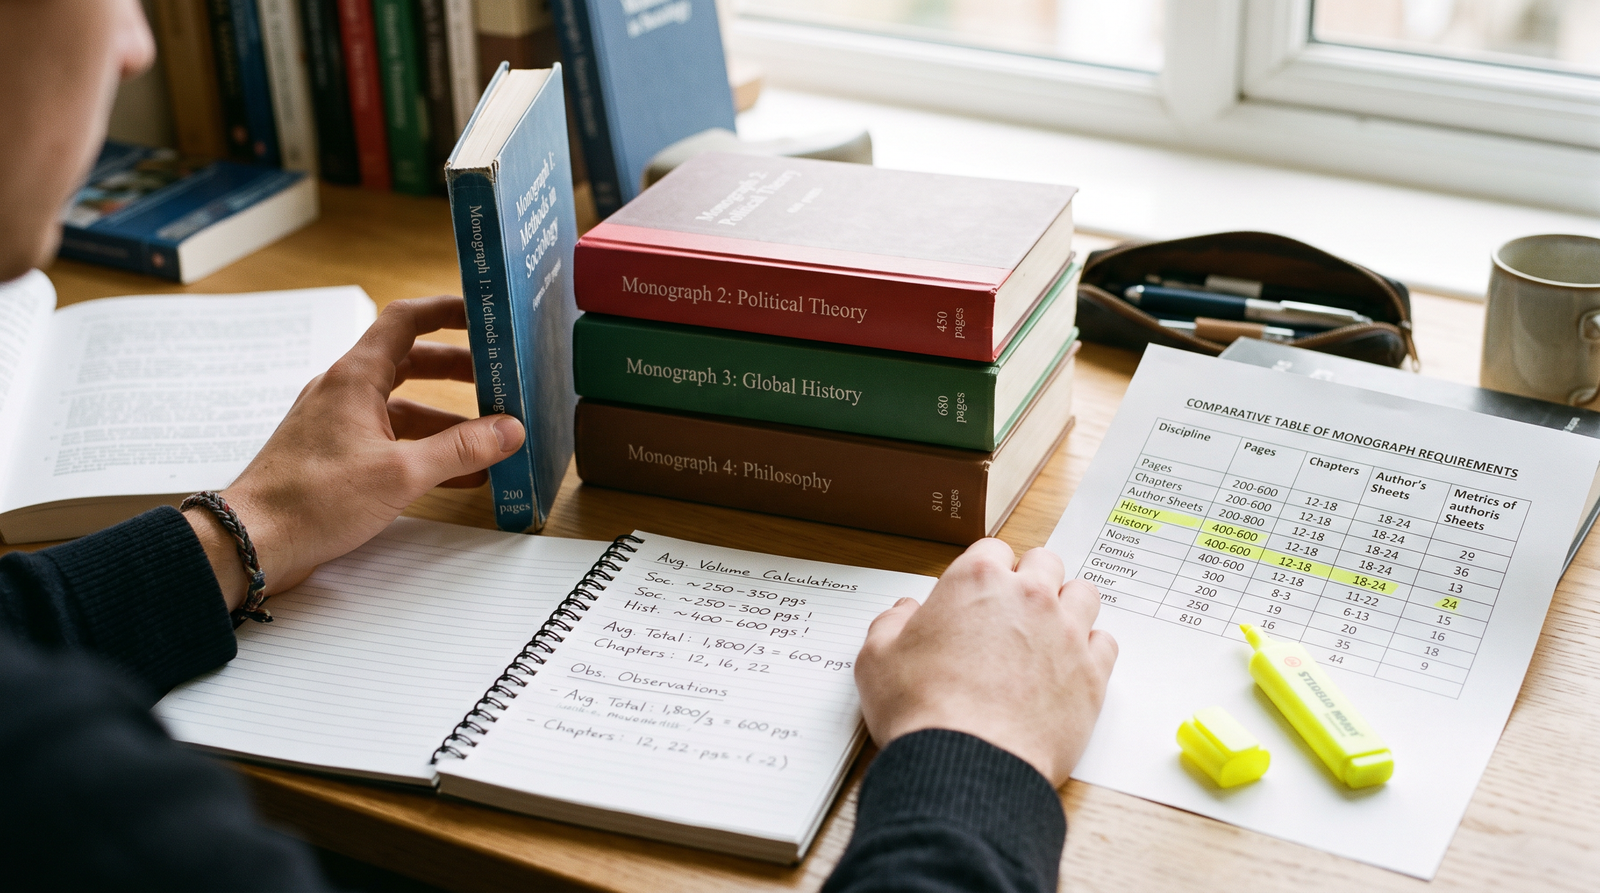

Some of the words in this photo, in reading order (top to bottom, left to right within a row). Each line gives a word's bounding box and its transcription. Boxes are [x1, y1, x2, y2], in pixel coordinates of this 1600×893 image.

[516, 159, 550, 221] Monograph
[470, 205, 490, 274] Monograph
[519, 193, 549, 251] Methods
[526, 217, 558, 278] Sociology
[480, 279, 492, 290] 1:
[622, 276, 712, 304] Monograph
[717, 287, 732, 304] 2:
[738, 289, 803, 313] Political
[808, 298, 868, 324] Theory
[481, 294, 498, 344] Methods
[936, 311, 948, 332] 450
[955, 308, 966, 339] pages
[488, 347, 501, 359] in
[490, 362, 507, 414] Sociolog
[626, 358, 717, 386] Monograph
[722, 370, 737, 386] 3:
[742, 372, 796, 394] Global
[801, 379, 862, 406] History
[938, 396, 949, 416] 680
[956, 392, 967, 423] pages
[1159, 422, 1211, 442] Discipline
[1186, 398, 1272, 424] COMPARATIVE
[1274, 416, 1311, 433] TABLE
[1313, 426, 1330, 436] OF
[1331, 430, 1416, 455] MONOGRAPH
[1418, 448, 1519, 478] REQUIREMENTS
[1244, 442, 1277, 457] Pages
[628, 444, 718, 475] Monograph
[722, 460, 738, 476] 4:
[744, 462, 832, 493] Philosophy
[1310, 457, 1360, 476] Chapters
[500, 504, 530, 515] pages
[502, 490, 523, 500] 200
[932, 492, 943, 512] 810
[950, 489, 961, 519] pages
[1134, 472, 1182, 491] Chapters
[1225, 494, 1272, 512] 200-600
[1299, 512, 1332, 527] 12-18
[1372, 529, 1405, 544] 18-24
[1141, 458, 1173, 473] Pages
[1232, 479, 1278, 498] 200-600
[1305, 496, 1338, 512] 12-18
[1378, 514, 1411, 529] 18-24
[1370, 484, 1410, 500] Sheets
[1454, 488, 1499, 507] Metrics
[1503, 499, 1517, 510] of
[1127, 486, 1166, 503] Author
[1167, 496, 1204, 513] Sheets
[1218, 509, 1265, 527] 200-800
[1292, 526, 1325, 542] 12-18
[1365, 544, 1399, 560] 18-24
[1454, 566, 1469, 577] 36
[1444, 514, 1485, 531] Sheets
[1113, 514, 1153, 532] History
[1204, 538, 1251, 557] 400-600
[1278, 557, 1312, 572] 12-18
[1352, 575, 1386, 591] 18-24
[1441, 599, 1458, 610] 24
[1120, 500, 1160, 519] History
[1212, 523, 1258, 542] 400-600
[1285, 542, 1319, 557] 12-18
[1358, 560, 1392, 576] 18-24
[1448, 582, 1464, 594] 13
[645, 572, 674, 586] Soc.
[779, 596, 807, 608] pgs
[656, 552, 689, 570] Avg.
[699, 559, 750, 577] Volume
[762, 569, 858, 592] Calculations
[1198, 553, 1245, 572] 400-600
[1271, 572, 1304, 587] 12-18
[1346, 591, 1379, 607] 11-22
[1436, 615, 1451, 626] 15
[624, 600, 660, 614] Hist.
[635, 587, 666, 600] Soc.
[1202, 570, 1225, 583] 300
[1271, 589, 1291, 602] 8-3
[1343, 607, 1370, 621] 6-13
[1430, 631, 1446, 642] 16
[1084, 572, 1116, 586] Other
[1186, 600, 1209, 612] 250
[1260, 619, 1275, 630] 16
[1335, 639, 1351, 650] 35
[1420, 662, 1429, 671] 9
[1179, 614, 1202, 626] 810
[1329, 654, 1344, 664] 44
[1195, 586, 1217, 598] 200
[1267, 604, 1282, 615] 19
[1341, 624, 1357, 635] 20
[1424, 646, 1439, 657] 18
[603, 621, 636, 638] Avg.
[703, 637, 765, 656] 1,800/3
[789, 650, 822, 663] 600
[824, 659, 852, 670] pgs
[570, 663, 606, 678] Obs.
[618, 671, 728, 697] Observations
[748, 663, 771, 674] 22
[564, 689, 598, 707] Avg.
[662, 704, 713, 727] 1,800/3
[737, 719, 769, 733] 600
[668, 741, 689, 753] 22
